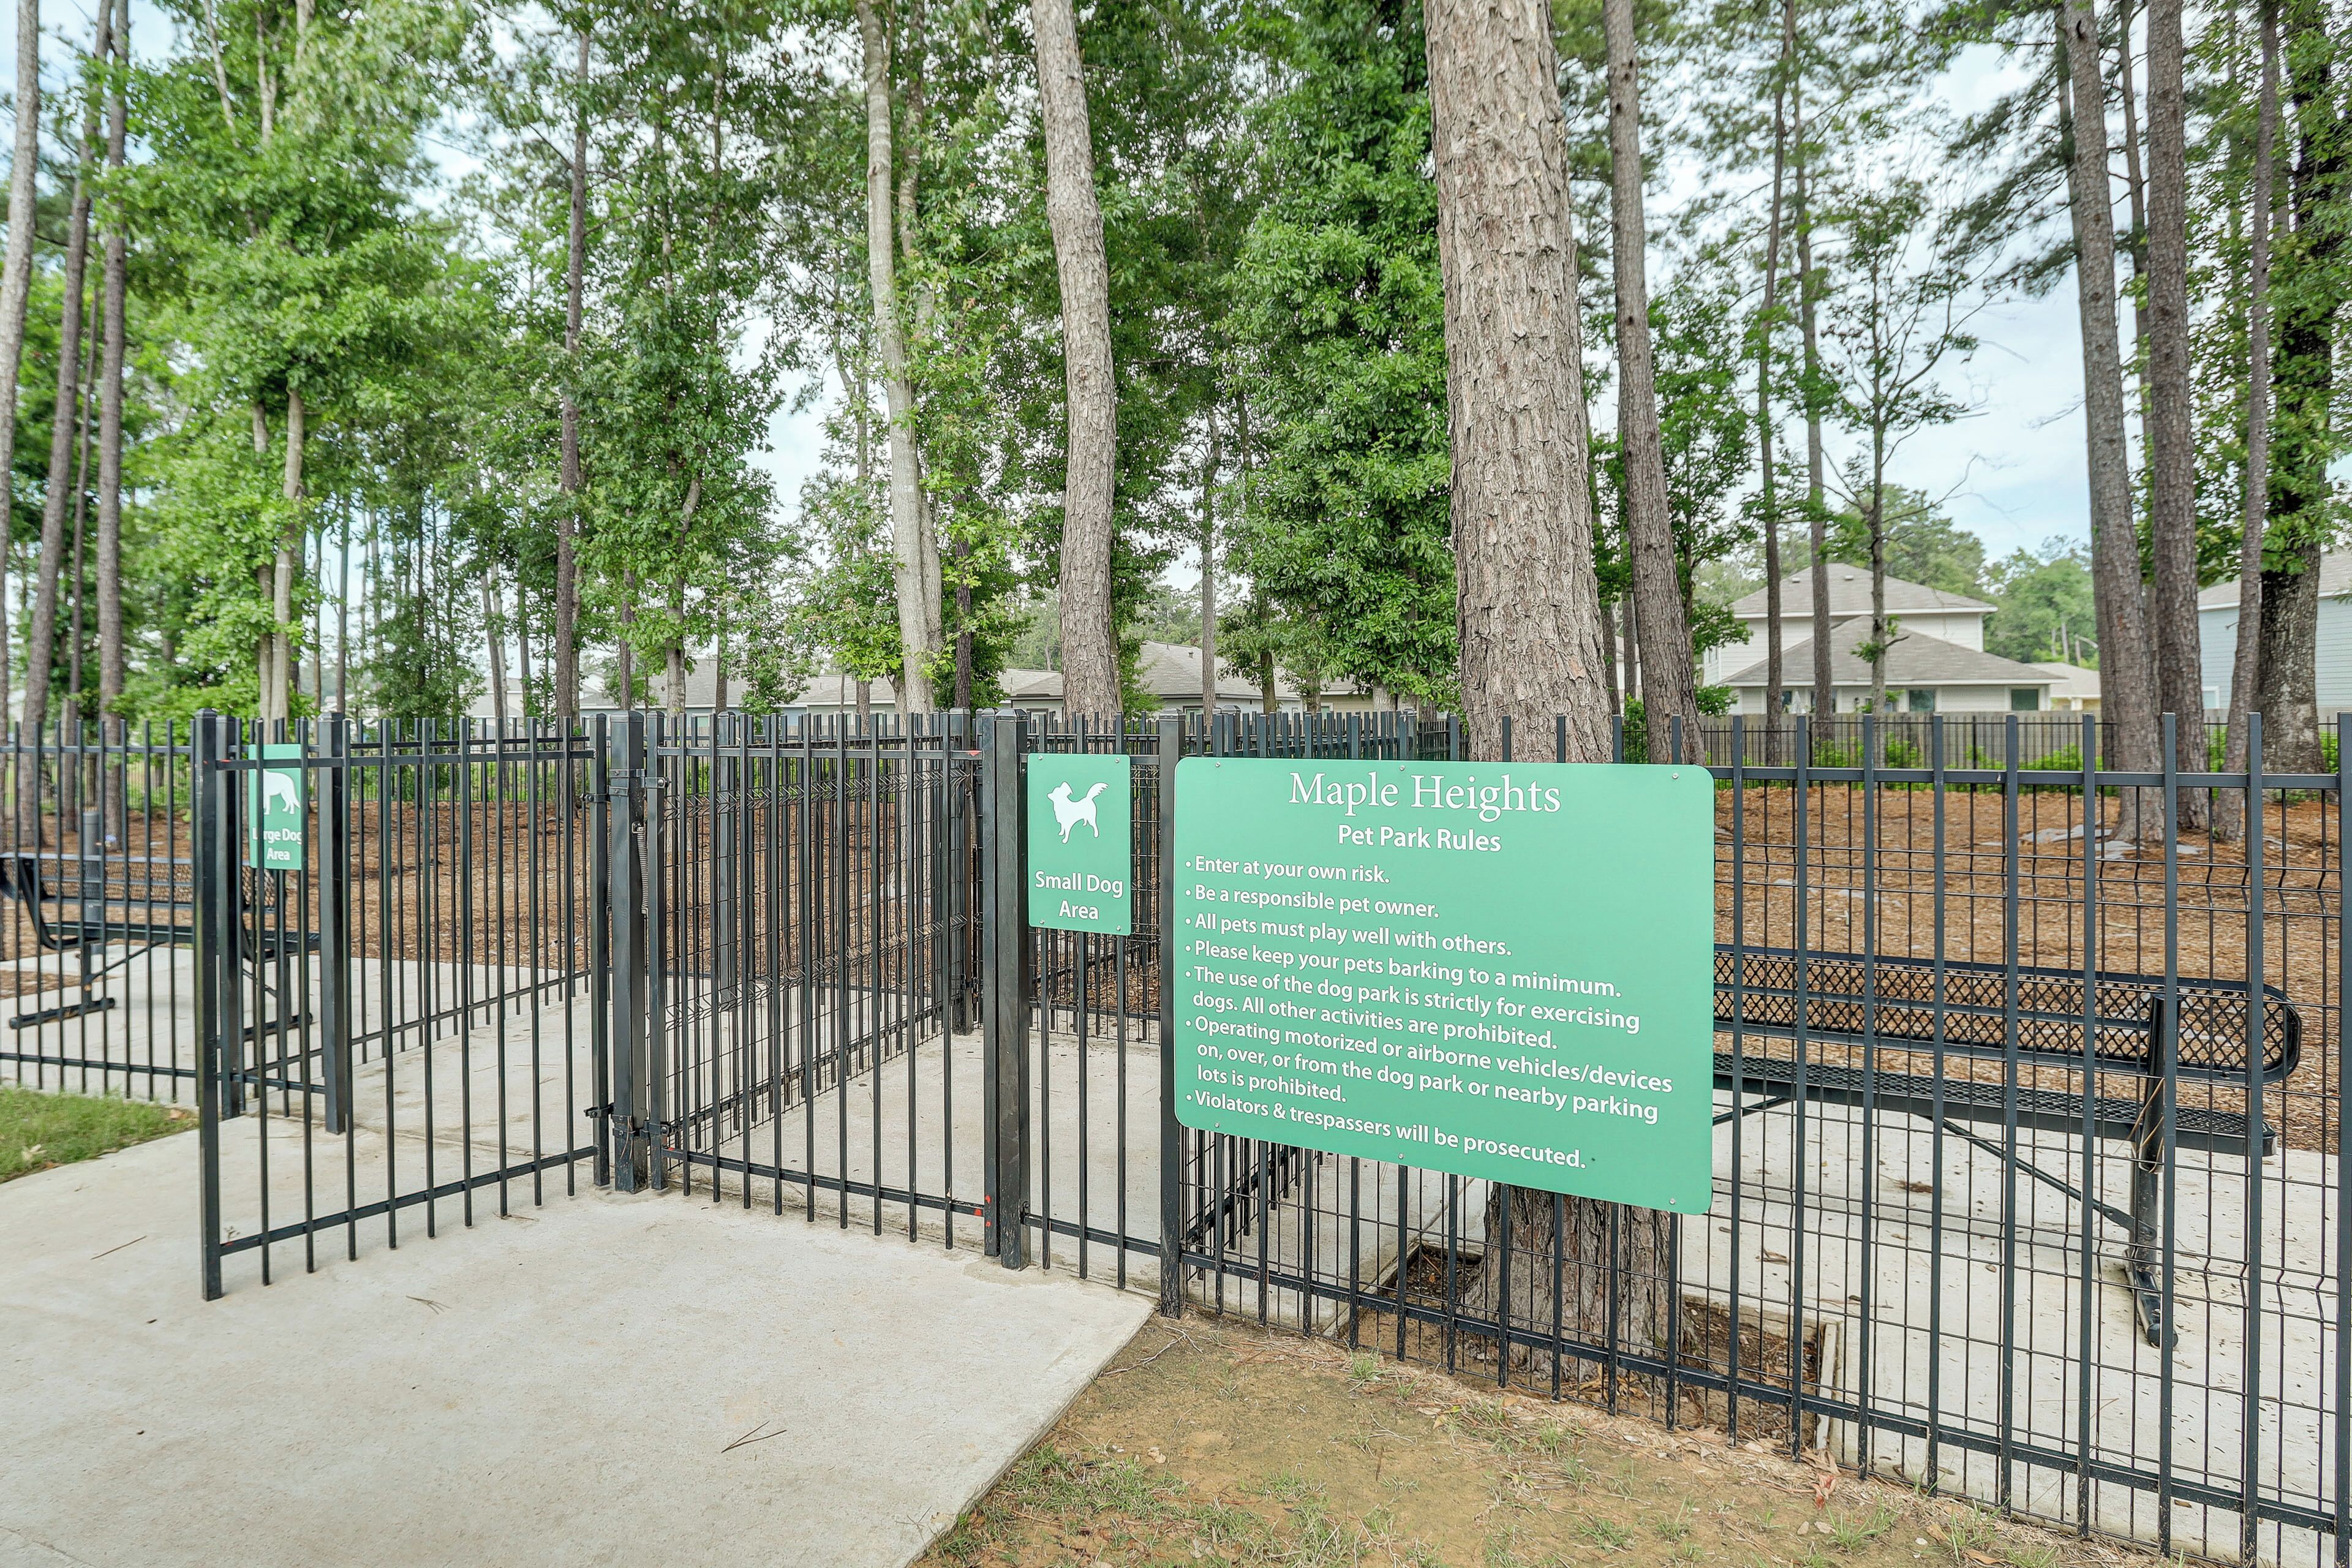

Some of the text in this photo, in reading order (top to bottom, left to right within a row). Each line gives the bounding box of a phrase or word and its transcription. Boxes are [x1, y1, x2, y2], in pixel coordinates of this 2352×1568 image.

[1289, 771, 1561, 823] Maple Heights
[252, 828, 281, 843] Lrge
[266, 848, 290, 860] Area
[1339, 824, 1501, 852] Pet Park Rules
[1035, 871, 1123, 899] Small Dog
[1196, 856, 1389, 883] Enter at your own risk.
[1059, 900, 1098, 920] Area
[1196, 884, 1439, 918] Be a responsible pet owner.
[1195, 913, 1512, 956] All pets must play well with others.
[1196, 940, 1621, 997] Please keep your pets barking to a minimum.
[1193, 990, 1557, 1049] dogs. All other activities are prohibited.
[1194, 965, 1640, 1034] The use of the dog park is strictly for exercising
[1195, 1016, 1673, 1093] Operating motorized or airborne vehicles/devices
[1197, 1044, 1657, 1125] on, over, or from the dog park or nearby parking
[1198, 1064, 1346, 1102] lots is prohibited.
[1194, 1090, 1586, 1169] Violators & trespassers will be prosecuted.
